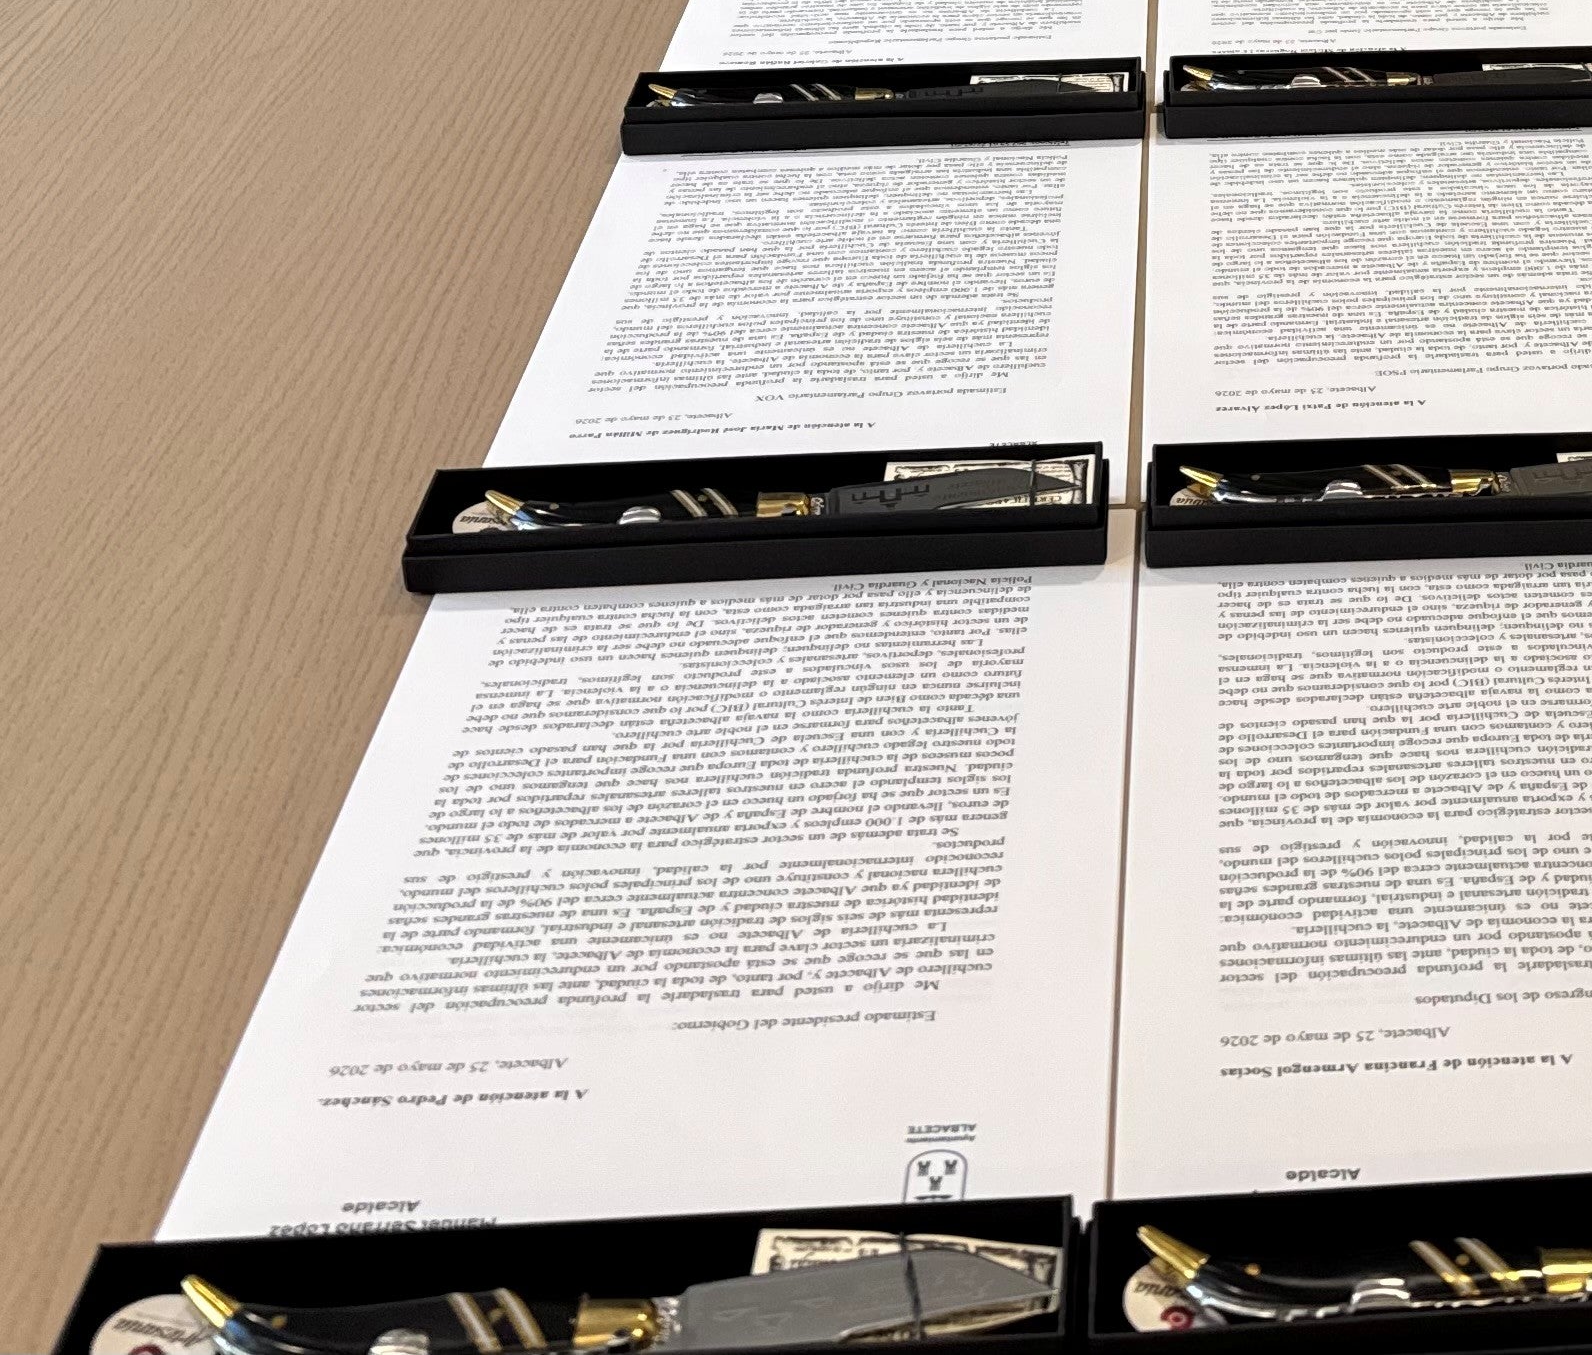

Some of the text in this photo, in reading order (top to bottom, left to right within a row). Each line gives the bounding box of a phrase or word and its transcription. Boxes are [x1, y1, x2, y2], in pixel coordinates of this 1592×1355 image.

[867, 580, 918, 590] Guardia
[920, 578, 930, 586] y
[931, 577, 987, 588] Nacional
[990, 575, 1033, 585] Policía
[1307, 964, 1407, 982] preocupación
[1416, 961, 1484, 976] profunda
[1492, 961, 1508, 973] la
[1218, 973, 1264, 983] sector
[1274, 971, 1298, 984] del
[1414, 990, 1492, 1007] Diputados
[1495, 992, 1518, 1004] los
[1522, 991, 1541, 1003] de
[781, 1010, 861, 1028] presidente
[863, 1010, 936, 1024] Estimado
[753, 1018, 779, 1031] del
[1219, 1026, 1451, 1047] Albacete, 25 de mayo de 2026
[328, 1057, 569, 1077] Albacete, 25 de mayo de 2026
[1220, 1053, 1573, 1079] A la atención de Francina Armengol Socías
[396, 1094, 448, 1107] Pedro
[452, 1093, 474, 1105] de
[477, 1090, 550, 1104] atención
[553, 1089, 569, 1101] la
[574, 1089, 589, 1100] A
[907, 1123, 977, 1135] ALBACETE
[1285, 1167, 1361, 1182] Alcalde
[340, 1200, 421, 1215] Alcalde
